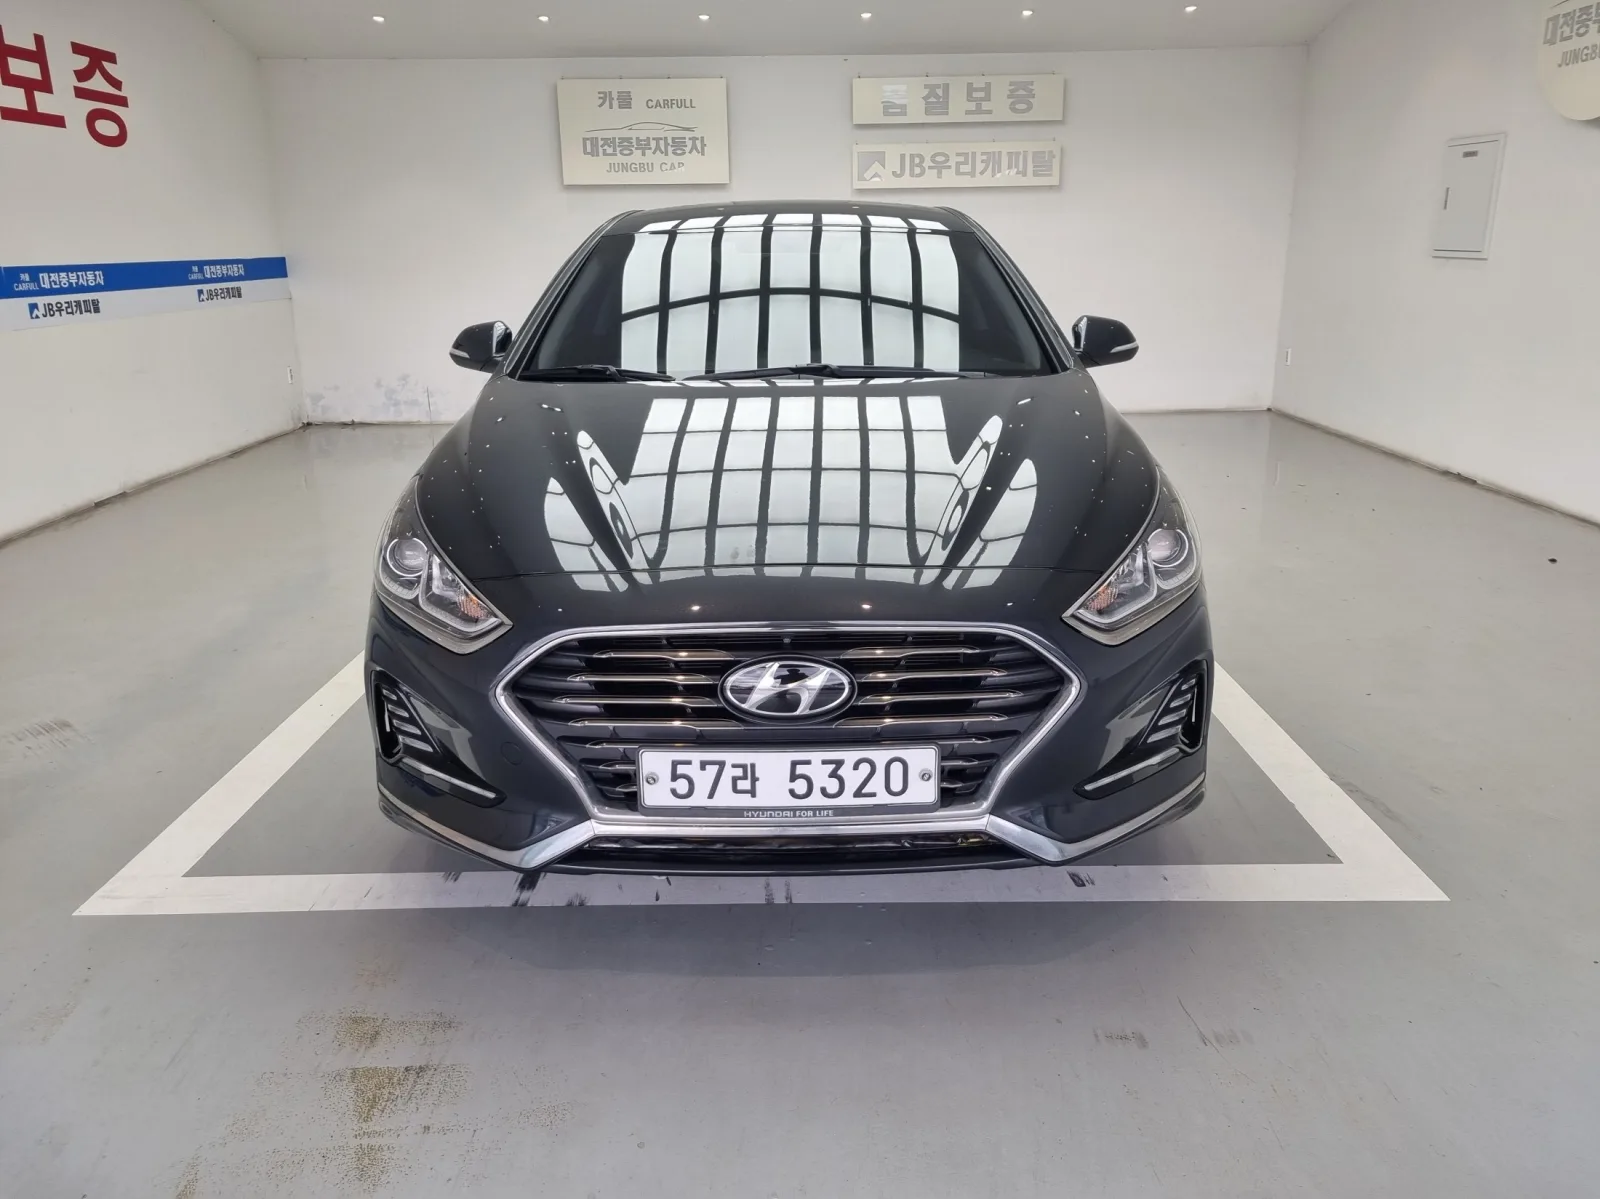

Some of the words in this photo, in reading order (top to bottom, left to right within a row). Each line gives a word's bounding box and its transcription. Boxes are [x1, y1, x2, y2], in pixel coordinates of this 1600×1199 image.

[1558, 43, 1600, 67] JUNGB
[646, 98, 696, 109] CARFULL
[582, 136, 707, 157] 대전중부자동차
[606, 162, 654, 173] JUNGBU
[892, 150, 1056, 179] JB우리캐피탈
[39, 270, 105, 289] 대전중부자동차
[204, 264, 245, 278] 대전중부자동차
[13, 282, 40, 291] CARFULL
[42, 298, 101, 318] JB우리캐피탈
[669, 758, 760, 799] 57라
[788, 756, 909, 799] 5320
